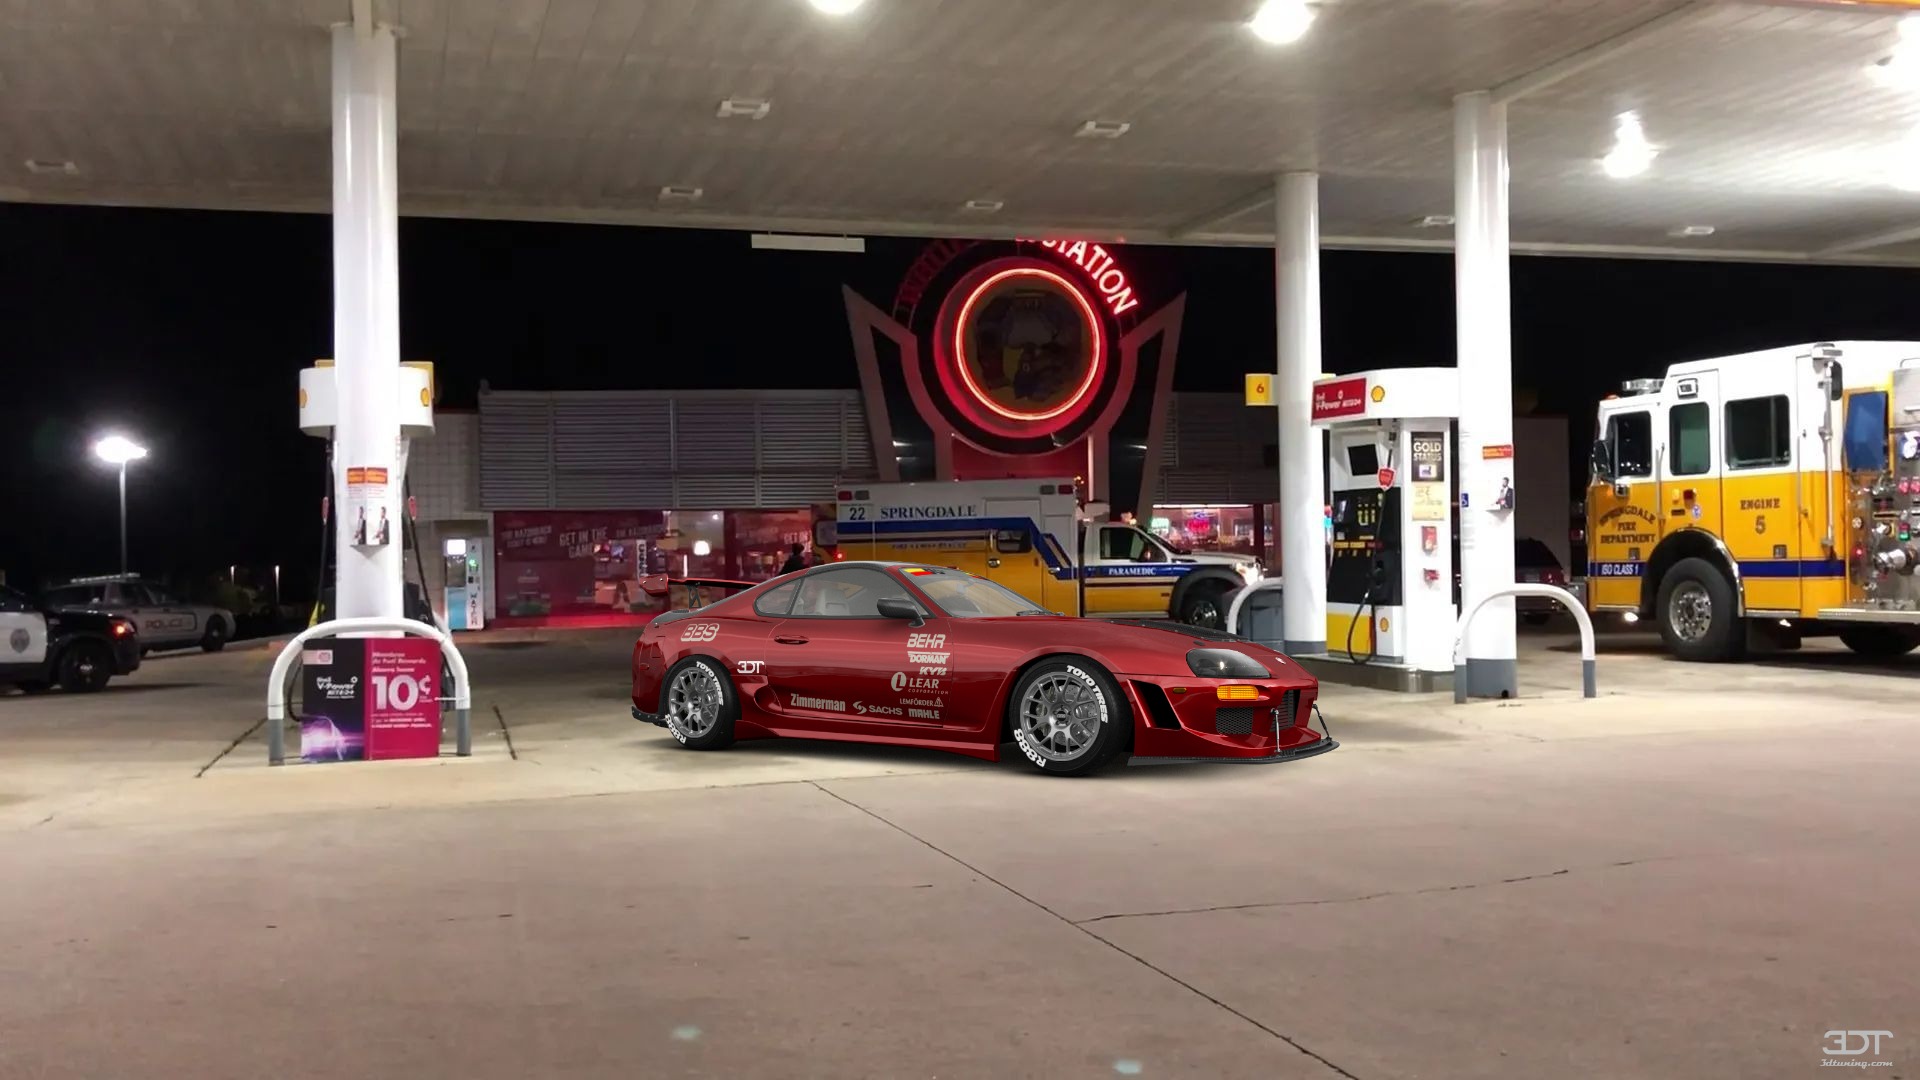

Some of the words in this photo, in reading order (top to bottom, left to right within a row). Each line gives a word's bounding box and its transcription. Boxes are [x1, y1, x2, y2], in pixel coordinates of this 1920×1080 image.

[1256, 383, 1265, 394] 6
[1413, 442, 1442, 453] GOLD
[1413, 453, 1442, 462] STATUS
[1740, 498, 1780, 510] ENGINE
[849, 507, 865, 520] 22
[880, 505, 977, 519] SPRINGDALE
[1618, 522, 1636, 531] FIRE
[1755, 515, 1766, 535] 5
[559, 532, 576, 547] GET
[578, 530, 589, 544] IN
[1600, 534, 1656, 544] DEPARTMENT
[1108, 567, 1156, 576] PARAMEDIC
[1613, 564, 1633, 575] CLASS
[1634, 564, 1639, 575] 1
[681, 623, 720, 641] BBS
[907, 633, 946, 649] BEHR
[908, 652, 950, 665] DORMAN
[737, 661, 764, 673] 3DT
[919, 666, 947, 676] KYB
[696, 661, 715, 678] TOYO
[713, 676, 724, 706] TIRES
[909, 678, 940, 689] LEAR
[1066, 665, 1095, 687] TOYO
[1093, 685, 1108, 723] TIRES
[790, 693, 846, 712] Zimmerman
[868, 705, 903, 716] SACHS
[908, 708, 940, 719] MAHLE
[1014, 728, 1047, 767] R888
